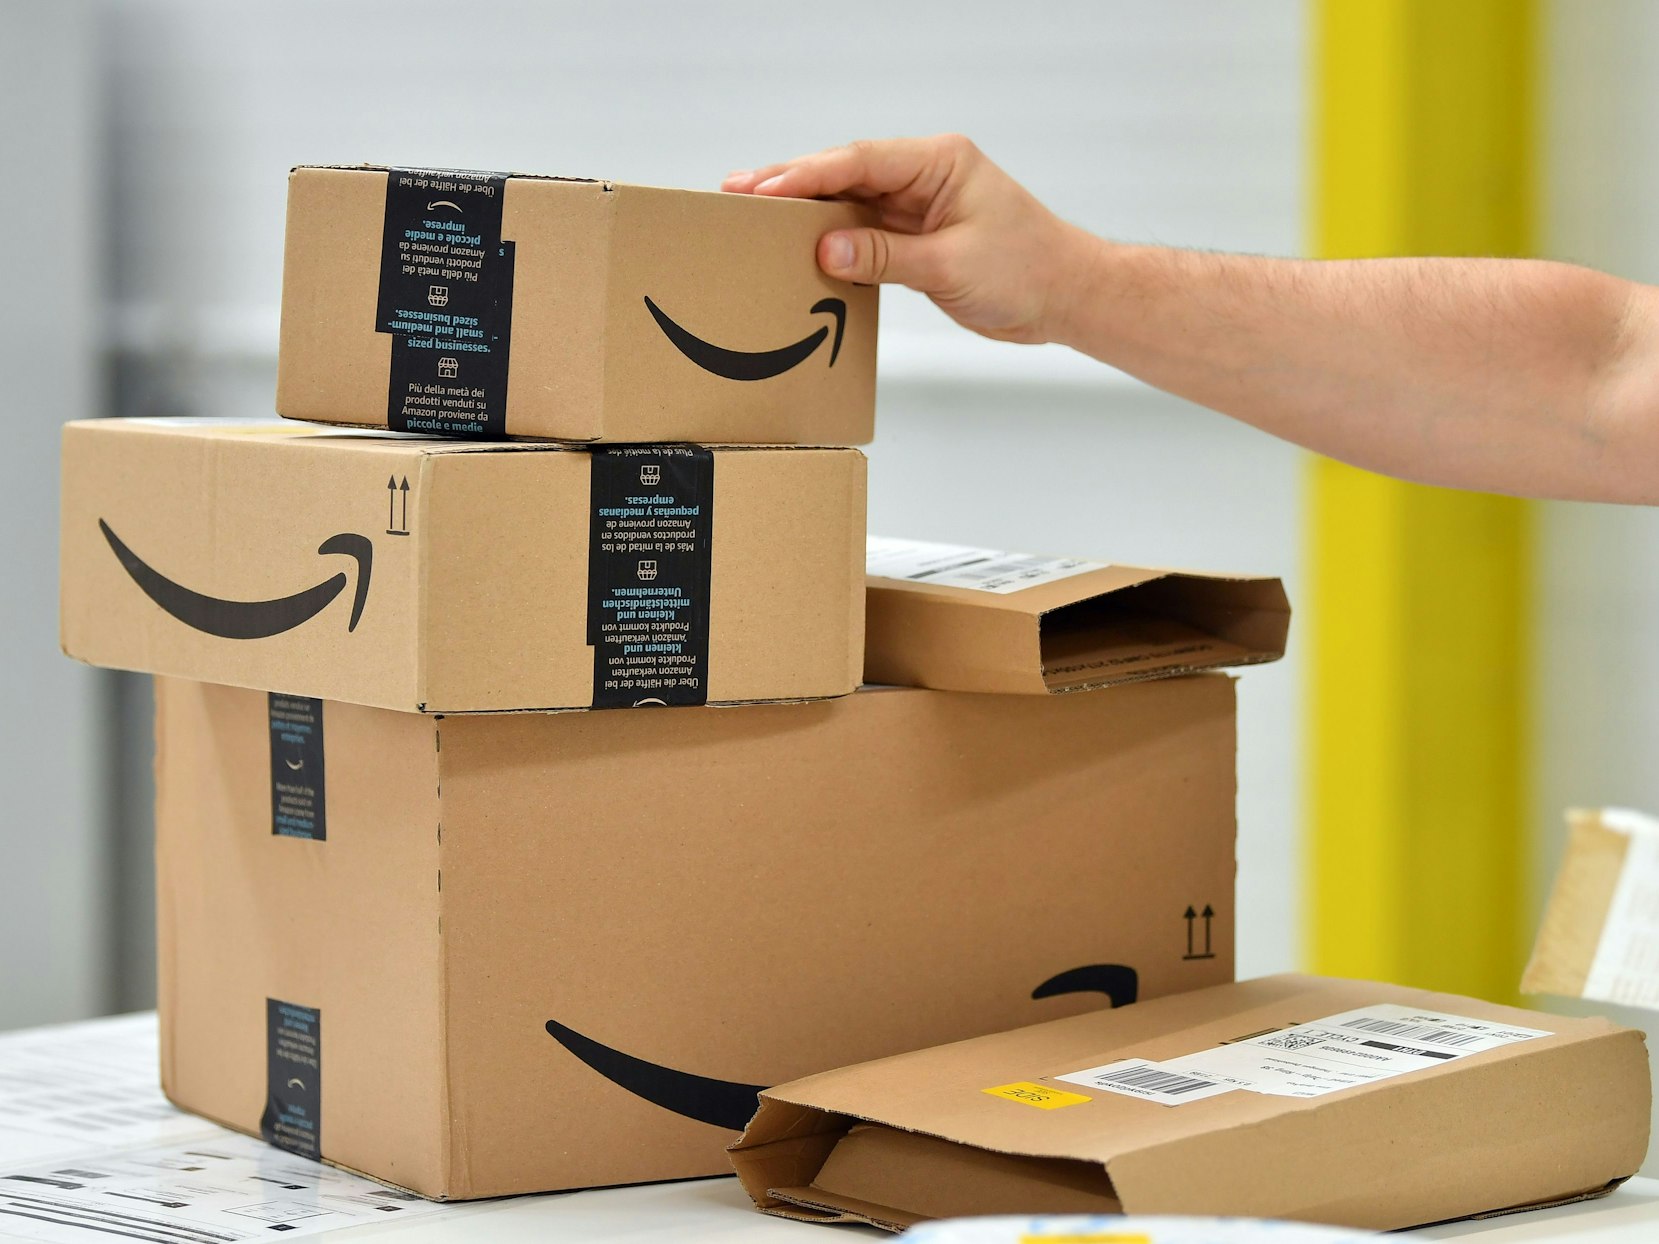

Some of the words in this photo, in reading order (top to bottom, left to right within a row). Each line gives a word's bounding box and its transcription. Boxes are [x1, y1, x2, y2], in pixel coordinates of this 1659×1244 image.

[399, 178, 412, 187] bei
[415, 180, 428, 190] der
[431, 181, 456, 192] Hälfte
[458, 184, 472, 194] die
[474, 185, 494, 197] Über
[423, 220, 465, 232] imprese.
[405, 230, 435, 242] medie
[446, 234, 480, 246] piccole
[399, 242, 409, 251] da
[412, 243, 448, 255] proviene
[451, 248, 485, 258] Amazon
[413, 255, 444, 265] venduti
[447, 257, 482, 269] prodotti
[402, 265, 415, 275] dei
[418, 267, 439, 276] metà
[442, 270, 462, 278] della
[464, 272, 478, 281] Più
[395, 310, 450, 324] businesses.
[453, 316, 478, 326] sized
[388, 321, 432, 332] medium-
[436, 325, 453, 334] and
[456, 327, 483, 339] small
[408, 338, 432, 348] sized
[435, 340, 490, 352] businesses.
[409, 383, 422, 392] Più
[424, 385, 445, 394] della
[447, 387, 469, 396] metà
[471, 388, 484, 397] dei
[406, 395, 440, 407] prodotti
[443, 399, 474, 408] venduti
[402, 406, 436, 416] Amazon
[438, 410, 475, 420] proviene
[478, 412, 488, 421] da
[407, 418, 441, 429] piccole
[452, 422, 482, 432] medie
[625, 494, 674, 505] empresas.
[599, 508, 644, 518] medianas
[646, 506, 652, 515] y
[654, 506, 699, 517] pequeñas
[606, 521, 617, 529] de
[619, 519, 655, 529] proviene
[657, 520, 691, 528] Amazon
[614, 532, 651, 541] vendidos
[654, 530, 695, 540] productos
[602, 544, 614, 552] los
[616, 544, 626, 552] de
[629, 543, 653, 552] mitad
[655, 543, 663, 552] la
[665, 543, 675, 552] de
[678, 542, 694, 552] Más
[612, 588, 681, 598] Unternehmen.
[603, 599, 690, 609] mittelständischen
[617, 611, 636, 621] und
[638, 610, 675, 620] kleinen
[620, 623, 649, 632] kommt
[651, 622, 689, 631] Produkte
[605, 634, 650, 644] verkauften
[652, 634, 685, 643] Amazon
[624, 645, 642, 654] und
[645, 644, 681, 654] kleinen
[626, 657, 656, 665] kommt
[658, 656, 696, 664] Produkte
[612, 668, 657, 677] verkauften
[659, 667, 692, 675] Amazon
[604, 680, 618, 690] bei
[620, 680, 634, 688] der
[636, 679, 661, 688] Hälfte
[664, 678, 676, 687] die
[678, 678, 698, 689] Über
